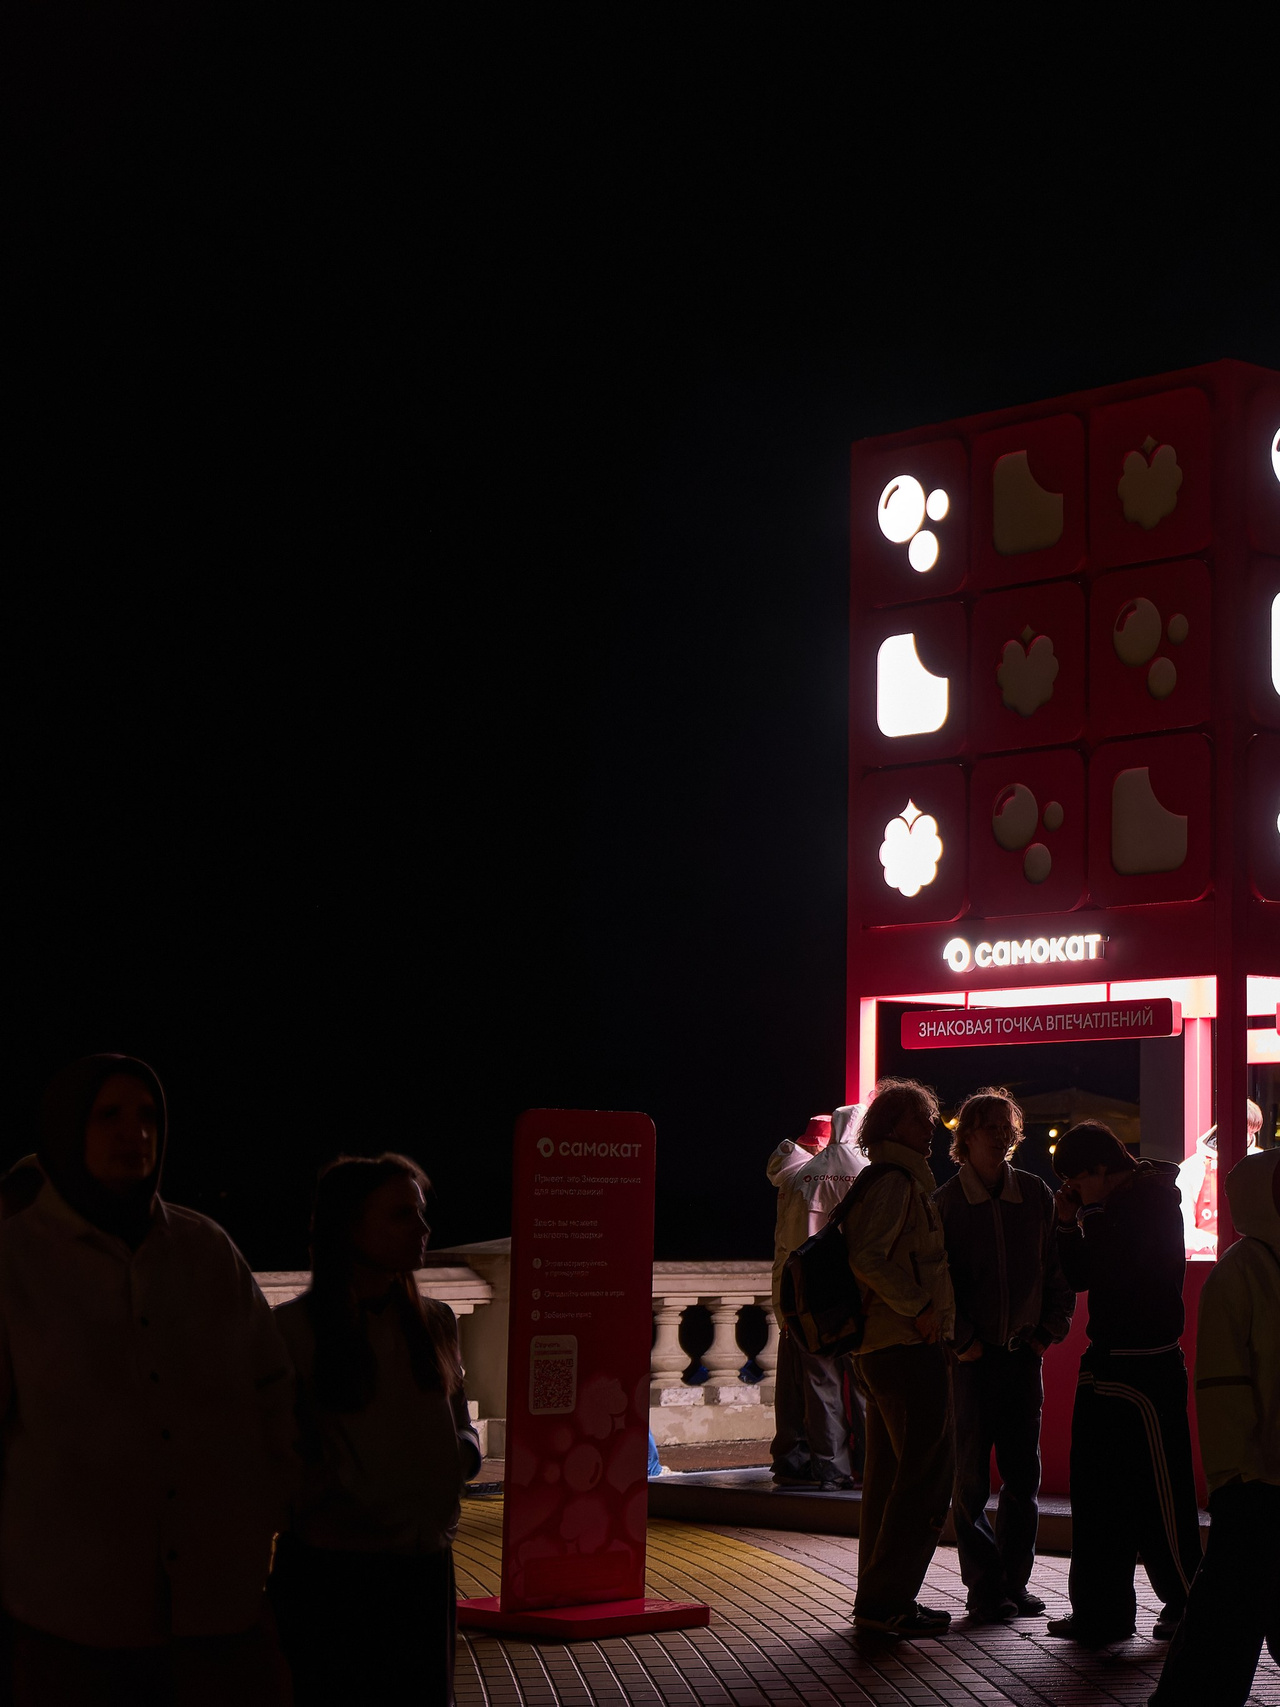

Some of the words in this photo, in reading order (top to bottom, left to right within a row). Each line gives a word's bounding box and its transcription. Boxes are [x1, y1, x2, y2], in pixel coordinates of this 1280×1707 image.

[975, 933, 1102, 968] самокат
[918, 1020, 993, 1038] ЗНАКОВАЯ
[995, 1017, 1044, 1034] ТОЧКА
[1046, 1006, 1154, 1031] ВПЕЧАТЛЕНИЙ
[559, 1141, 642, 1158] самокат
